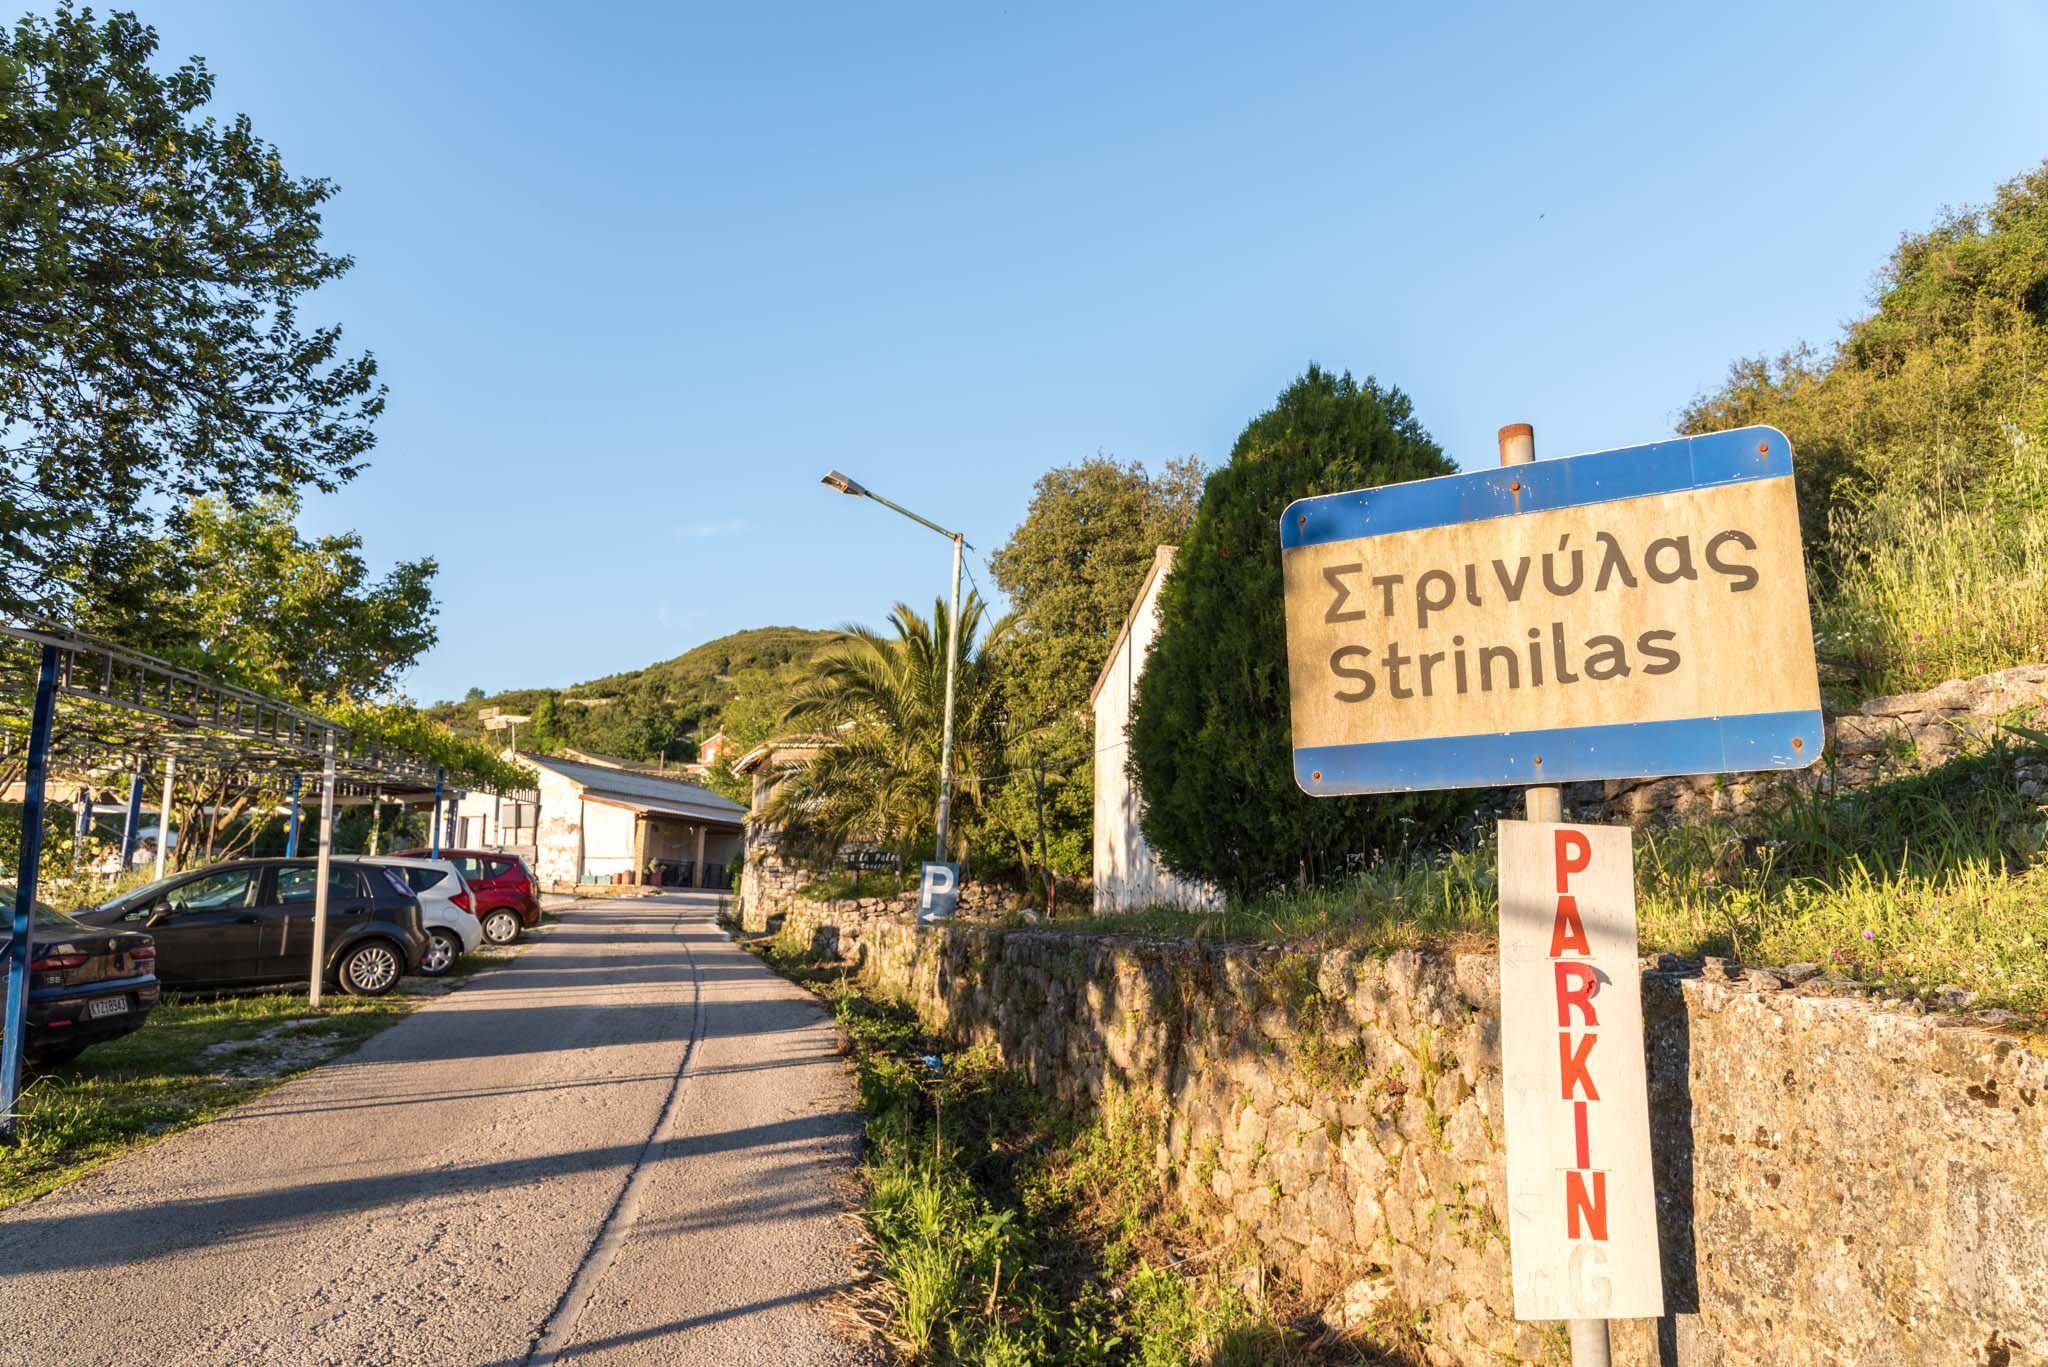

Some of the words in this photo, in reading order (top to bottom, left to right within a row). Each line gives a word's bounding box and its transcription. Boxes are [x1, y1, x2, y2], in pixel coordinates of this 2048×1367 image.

[1322, 529, 1760, 629] Στρινύλας
[1329, 621, 1681, 704] Strinilas
[922, 865, 954, 909] P
